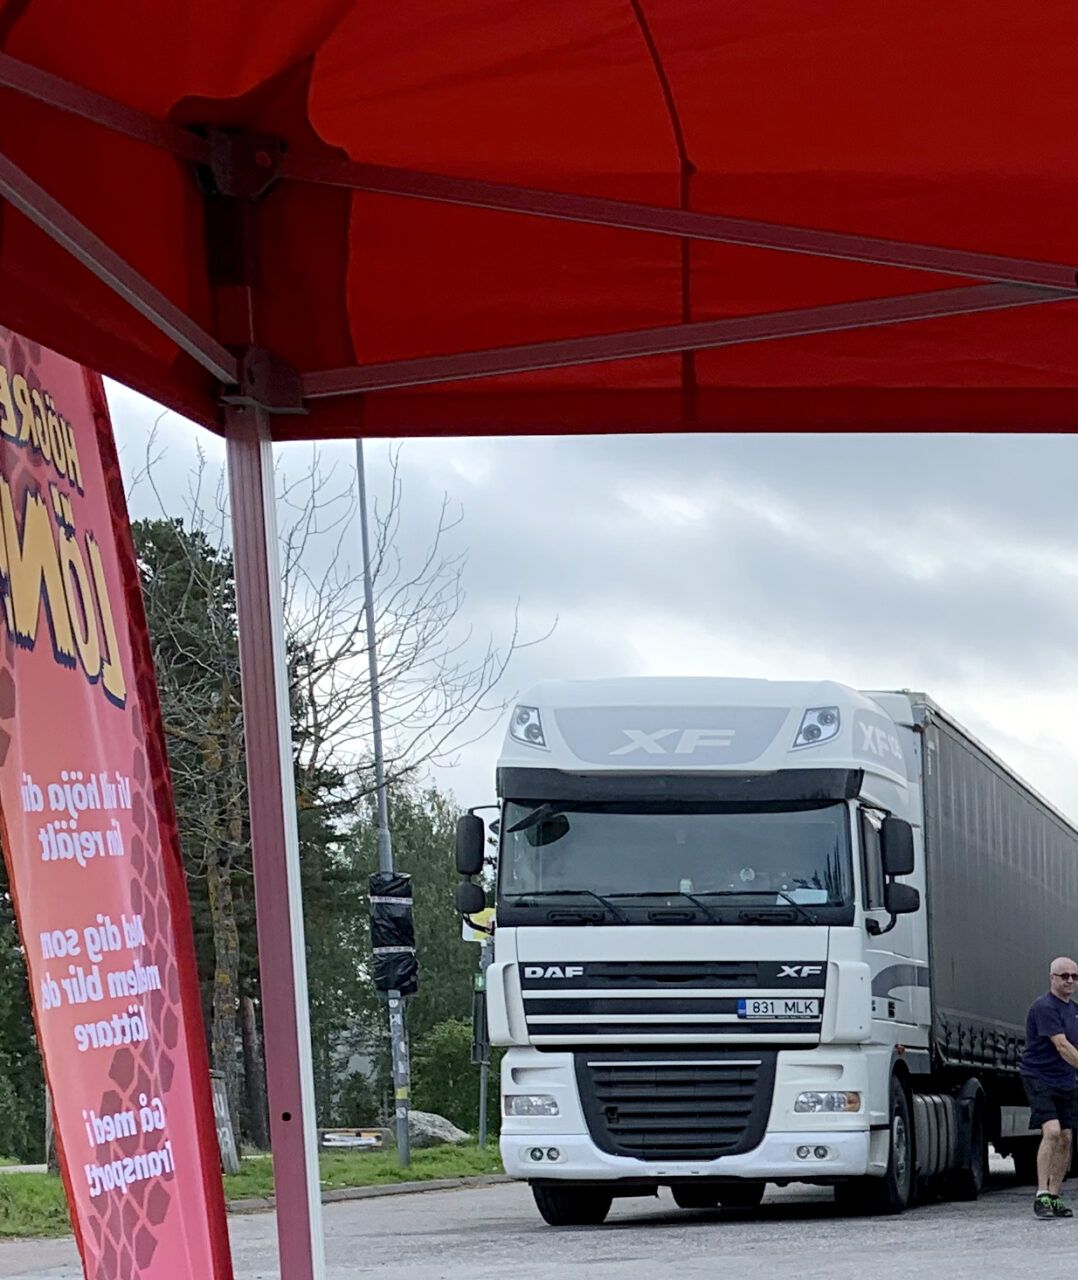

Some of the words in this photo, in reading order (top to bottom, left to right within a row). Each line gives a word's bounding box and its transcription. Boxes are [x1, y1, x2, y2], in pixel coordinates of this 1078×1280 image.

[608, 728, 736, 756] XF
[523, 966, 584, 979] DAF
[776, 965, 823, 978] XF
[752, 1001, 775, 1014] 831
[784, 1001, 814, 1014] MLK
